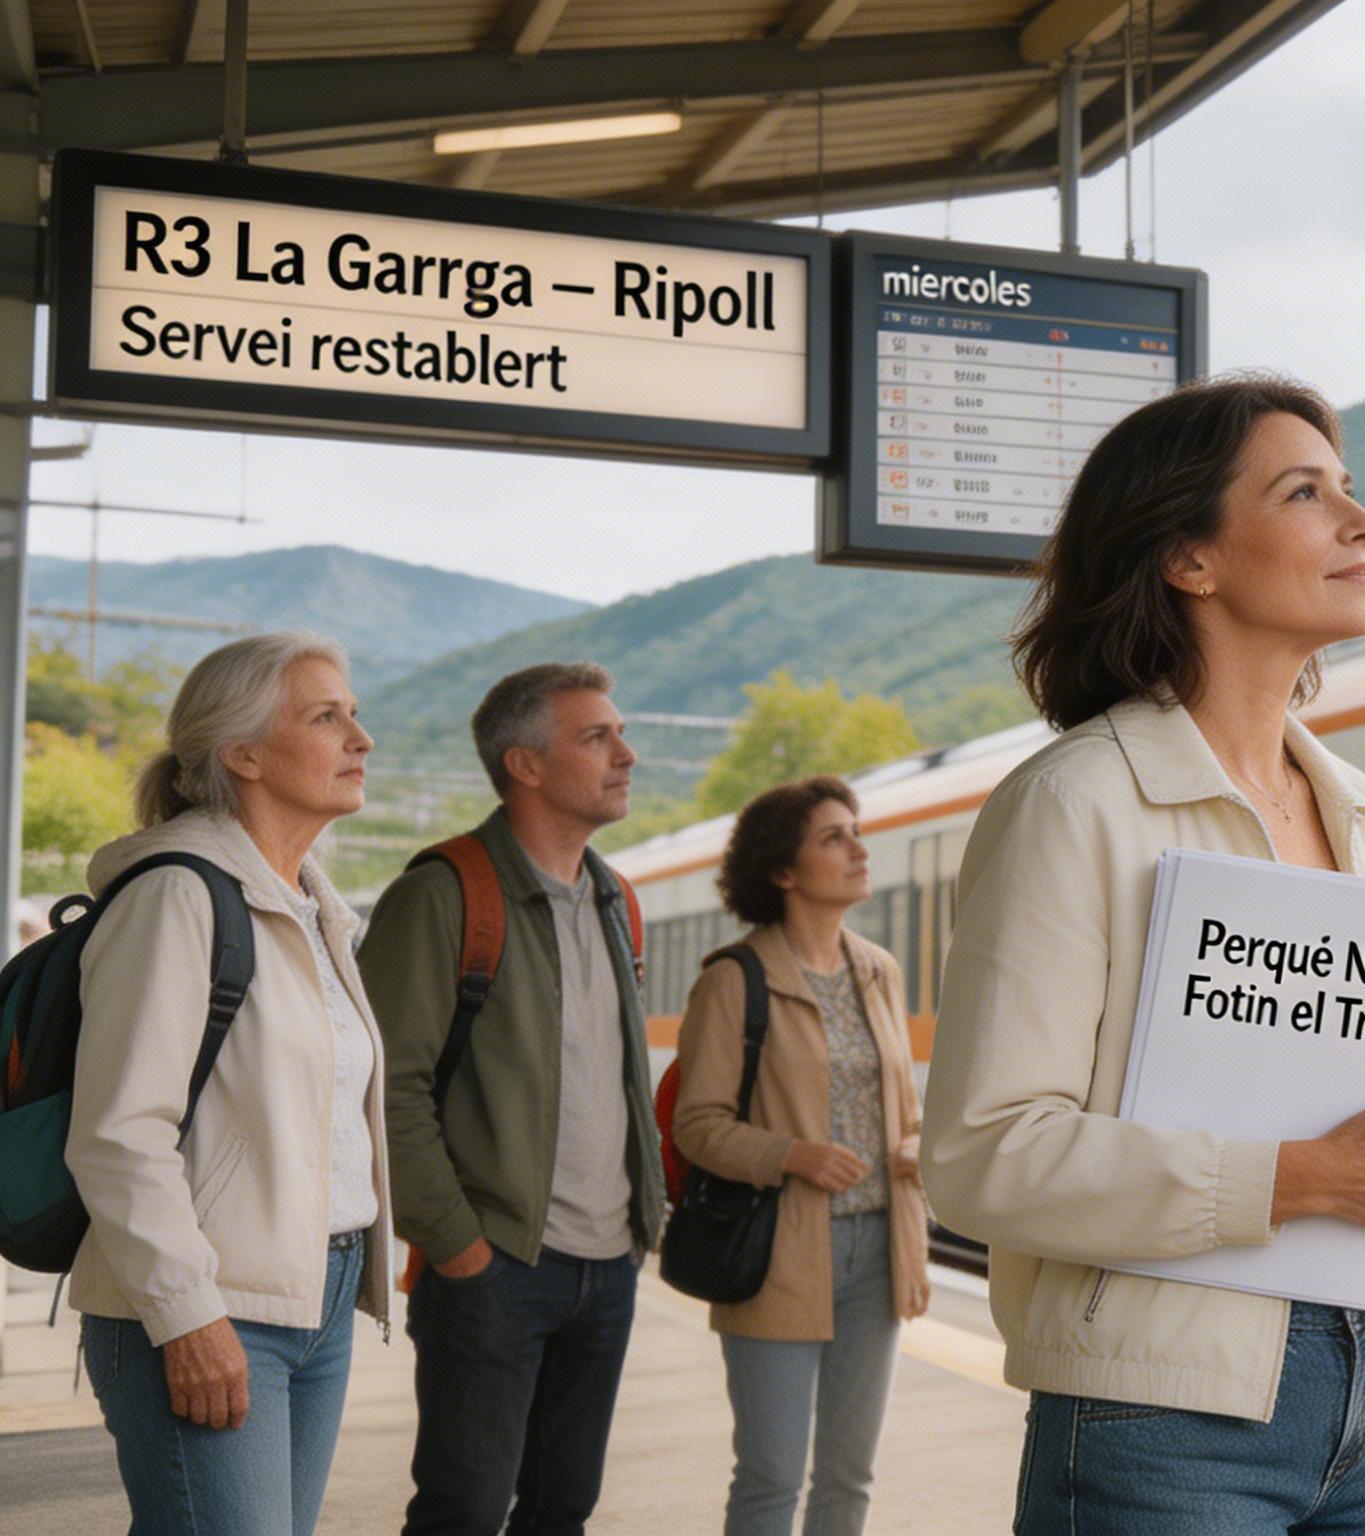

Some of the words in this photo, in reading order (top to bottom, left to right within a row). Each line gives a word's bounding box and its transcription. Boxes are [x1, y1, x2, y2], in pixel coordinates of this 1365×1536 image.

[124, 209, 211, 278] R3
[236, 220, 305, 286] La
[327, 233, 533, 319] Garrga
[614, 260, 775, 338] Ripoll
[882, 264, 1032, 308] miercoles
[119, 305, 292, 368] Servei
[311, 330, 568, 393] restablert
[1197, 918, 1334, 985] Perqué
[1183, 973, 1278, 1027] Fotin
[1290, 990, 1326, 1035] el
